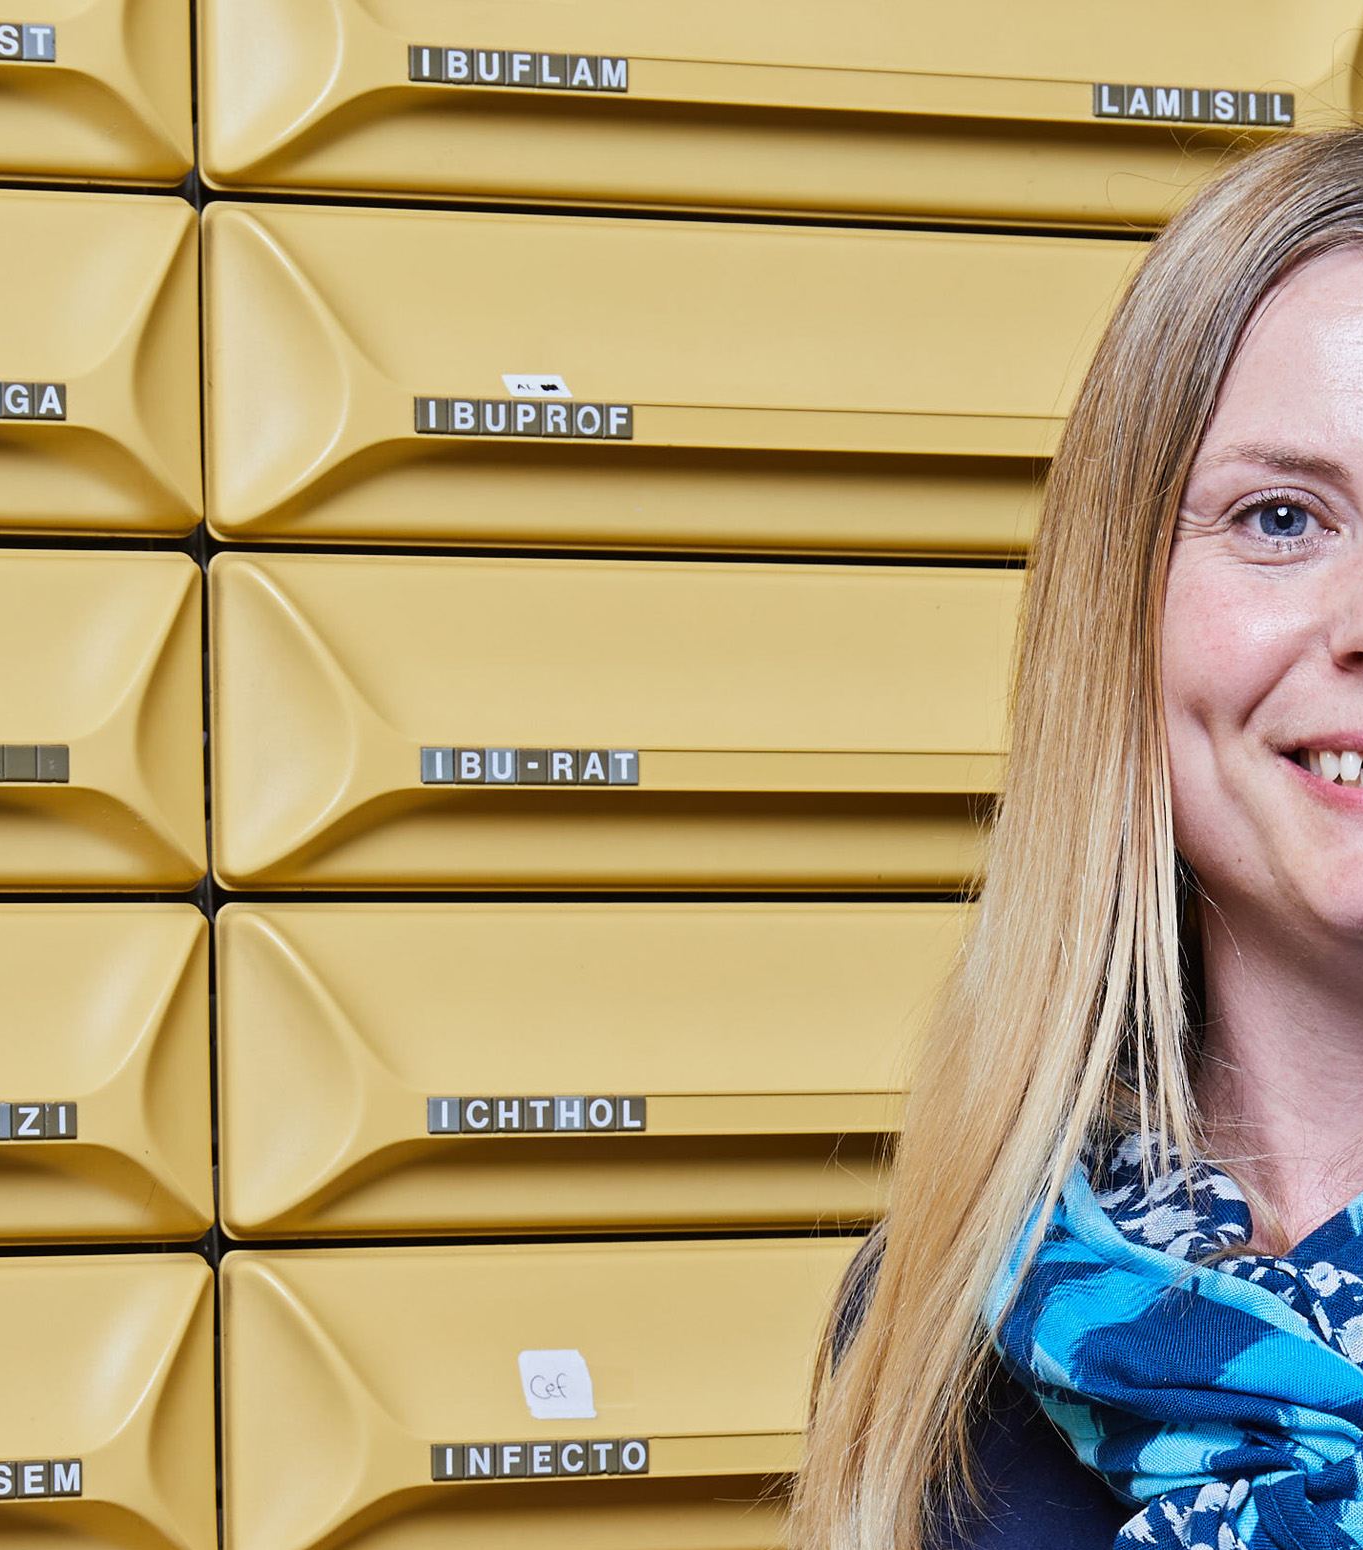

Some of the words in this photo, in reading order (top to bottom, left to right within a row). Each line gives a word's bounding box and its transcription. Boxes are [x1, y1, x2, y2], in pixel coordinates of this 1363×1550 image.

[422, 48, 627, 87] IBUFLAM
[1101, 85, 1291, 121] LAMISIL
[428, 399, 628, 435] IBUPROF
[435, 748, 635, 783] IBU-RAT
[441, 1098, 641, 1130] ICHTHOL
[446, 1441, 646, 1476] INFECTO
